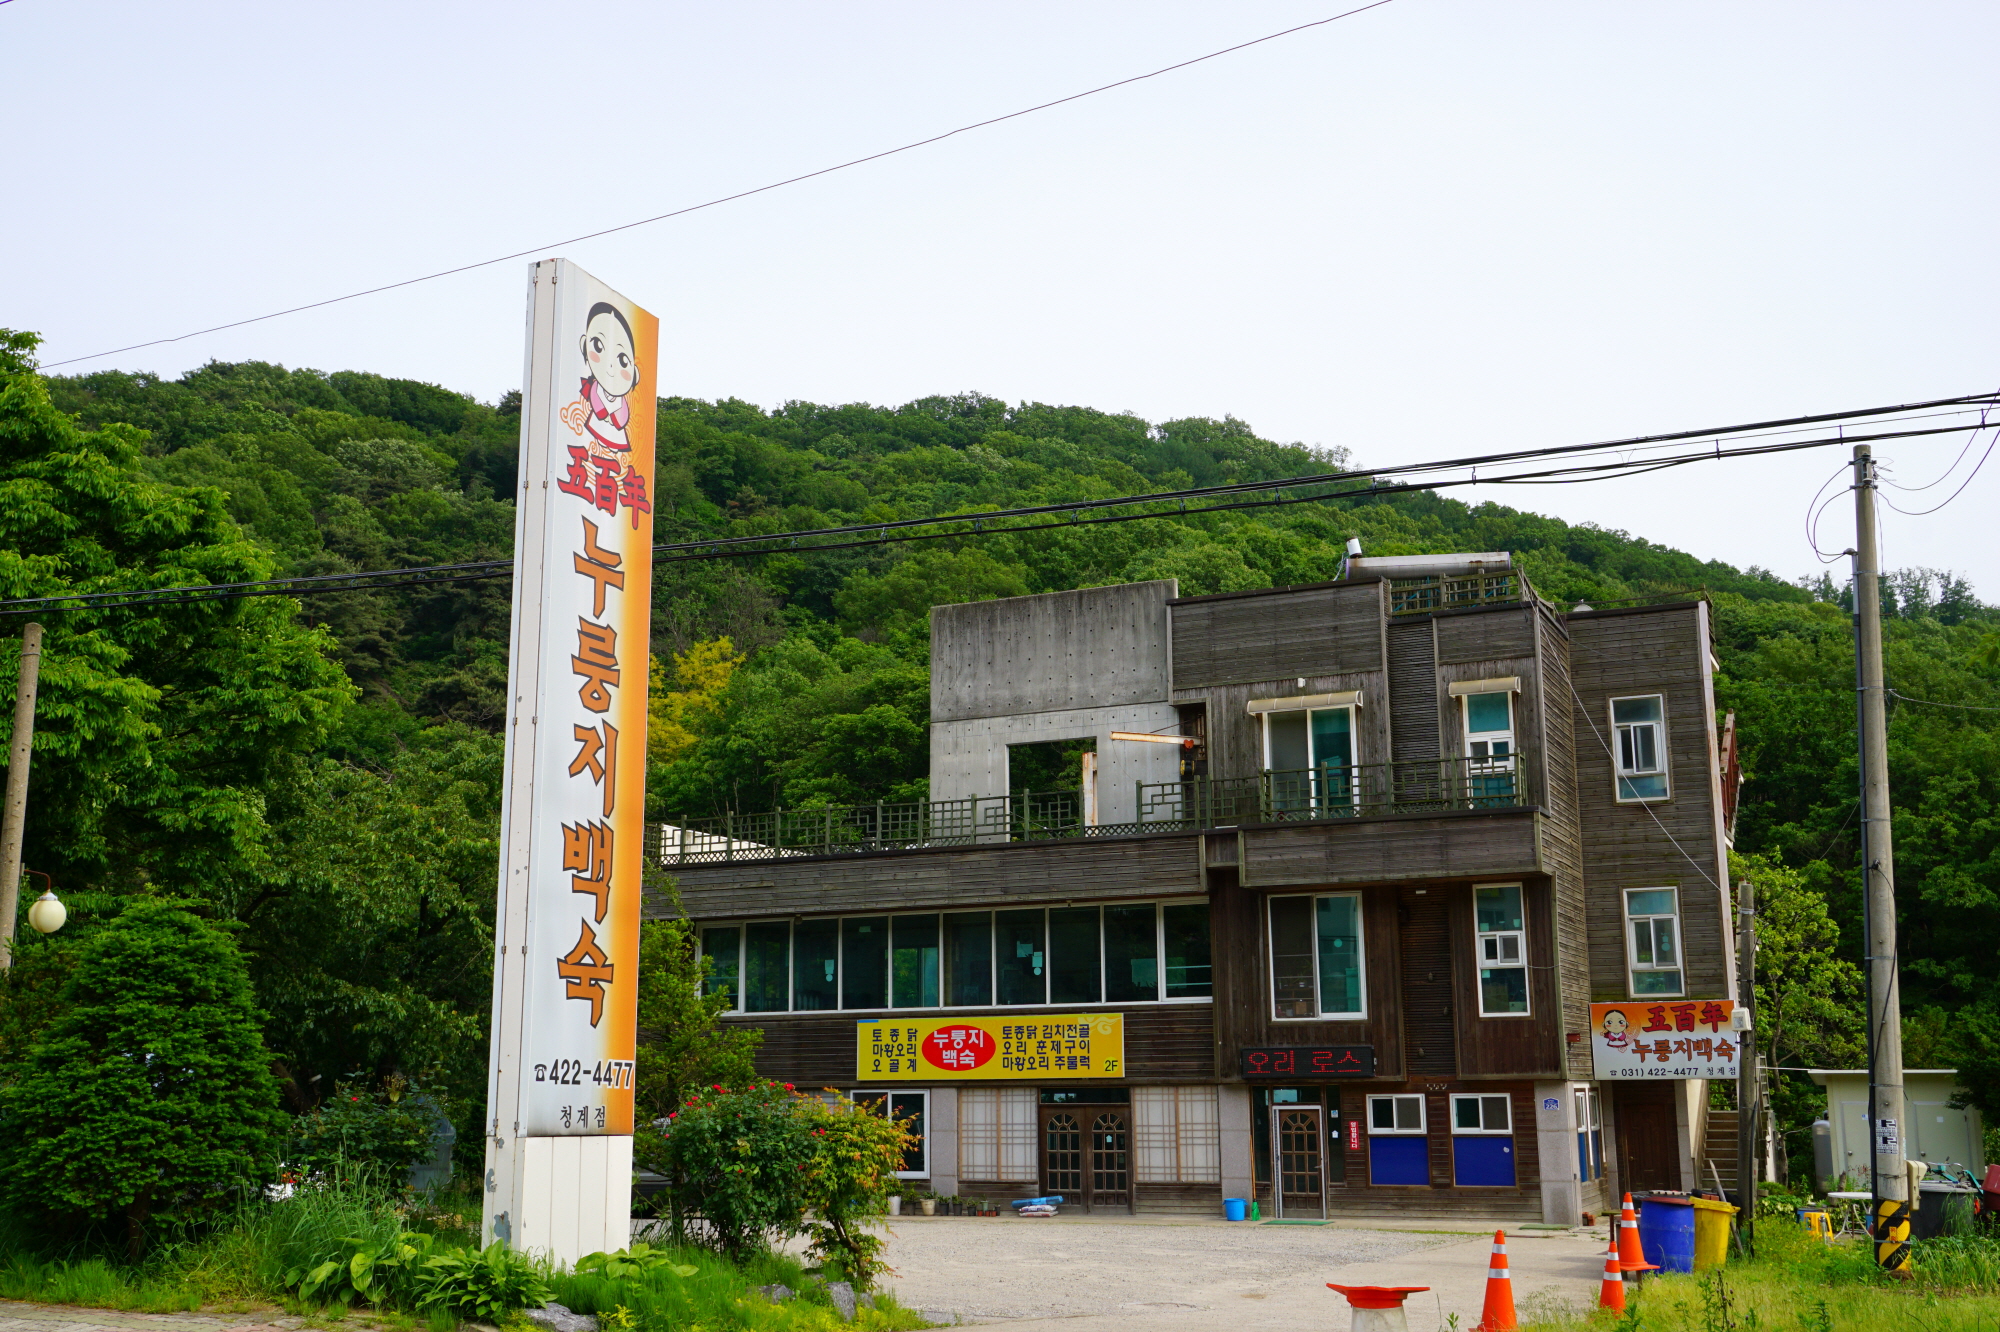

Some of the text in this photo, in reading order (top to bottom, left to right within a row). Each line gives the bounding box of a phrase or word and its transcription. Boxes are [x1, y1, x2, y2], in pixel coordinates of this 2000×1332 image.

[557, 444, 651, 531] 五百年
[556, 514, 625, 1028] 누룽지백숙
[1642, 1002, 1728, 1033] 五百年
[933, 1029, 984, 1049] 누룽지
[1002, 1024, 1090, 1040] 토종닭 김치전골
[872, 1043, 917, 1058] 마황오리
[1002, 1041, 1027, 1055] 오리
[1631, 1037, 1736, 1063] 누룽지백숙
[942, 1049, 975, 1067] 백숙
[1002, 1055, 1090, 1071] 마황오리 주물럭
[1104, 1060, 1118, 1071] 2F
[1247, 1050, 1362, 1074] 오리 로스
[548, 1058, 634, 1091] 422-4477
[1621, 1068, 1644, 1077] 031)
[1648, 1067, 1699, 1076] 422-4477
